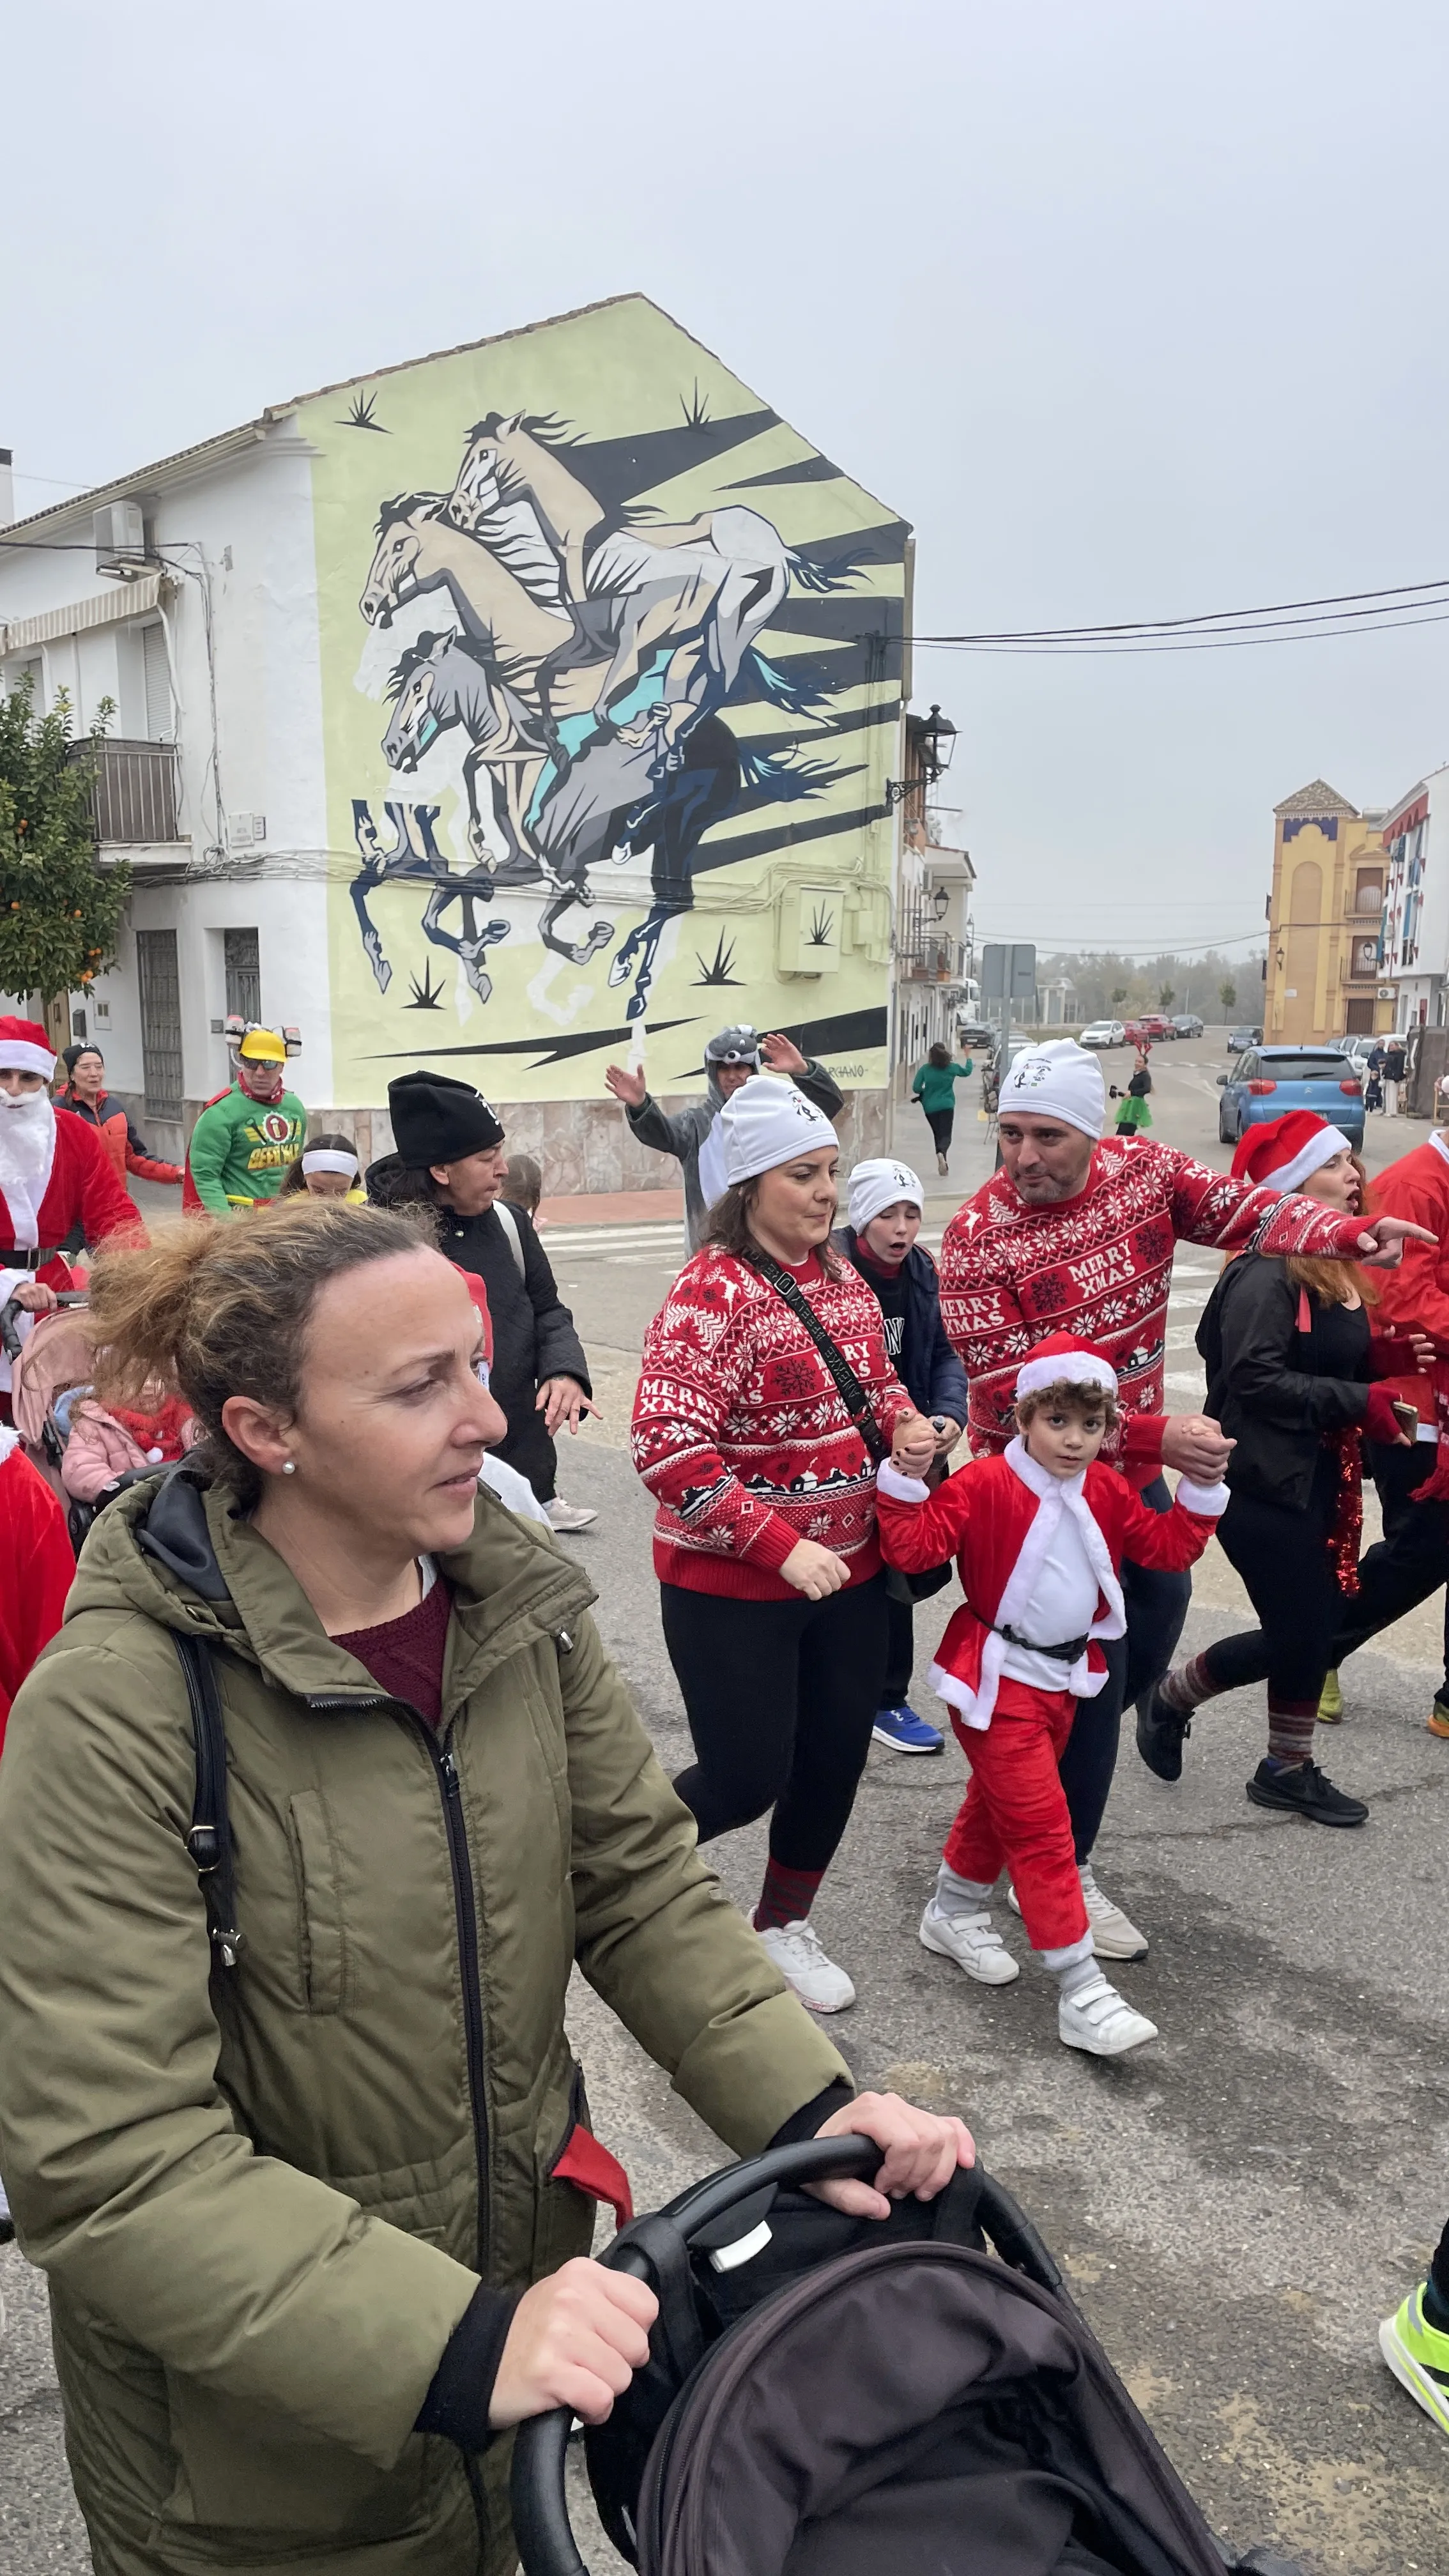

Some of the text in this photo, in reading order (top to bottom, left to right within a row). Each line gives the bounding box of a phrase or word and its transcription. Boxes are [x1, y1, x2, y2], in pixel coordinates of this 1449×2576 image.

[1068, 1239, 1131, 1282] MERRY
[1078, 1259, 1135, 1298] XMAS
[939, 1292, 1001, 1317] MERRY
[943, 1310, 1005, 1335] XMAS
[813, 1340, 871, 1370] MRY
[825, 1346, 861, 1398] ANEKKE
[639, 1397, 717, 1432] XMAS
[640, 1379, 721, 1421] MERRY
